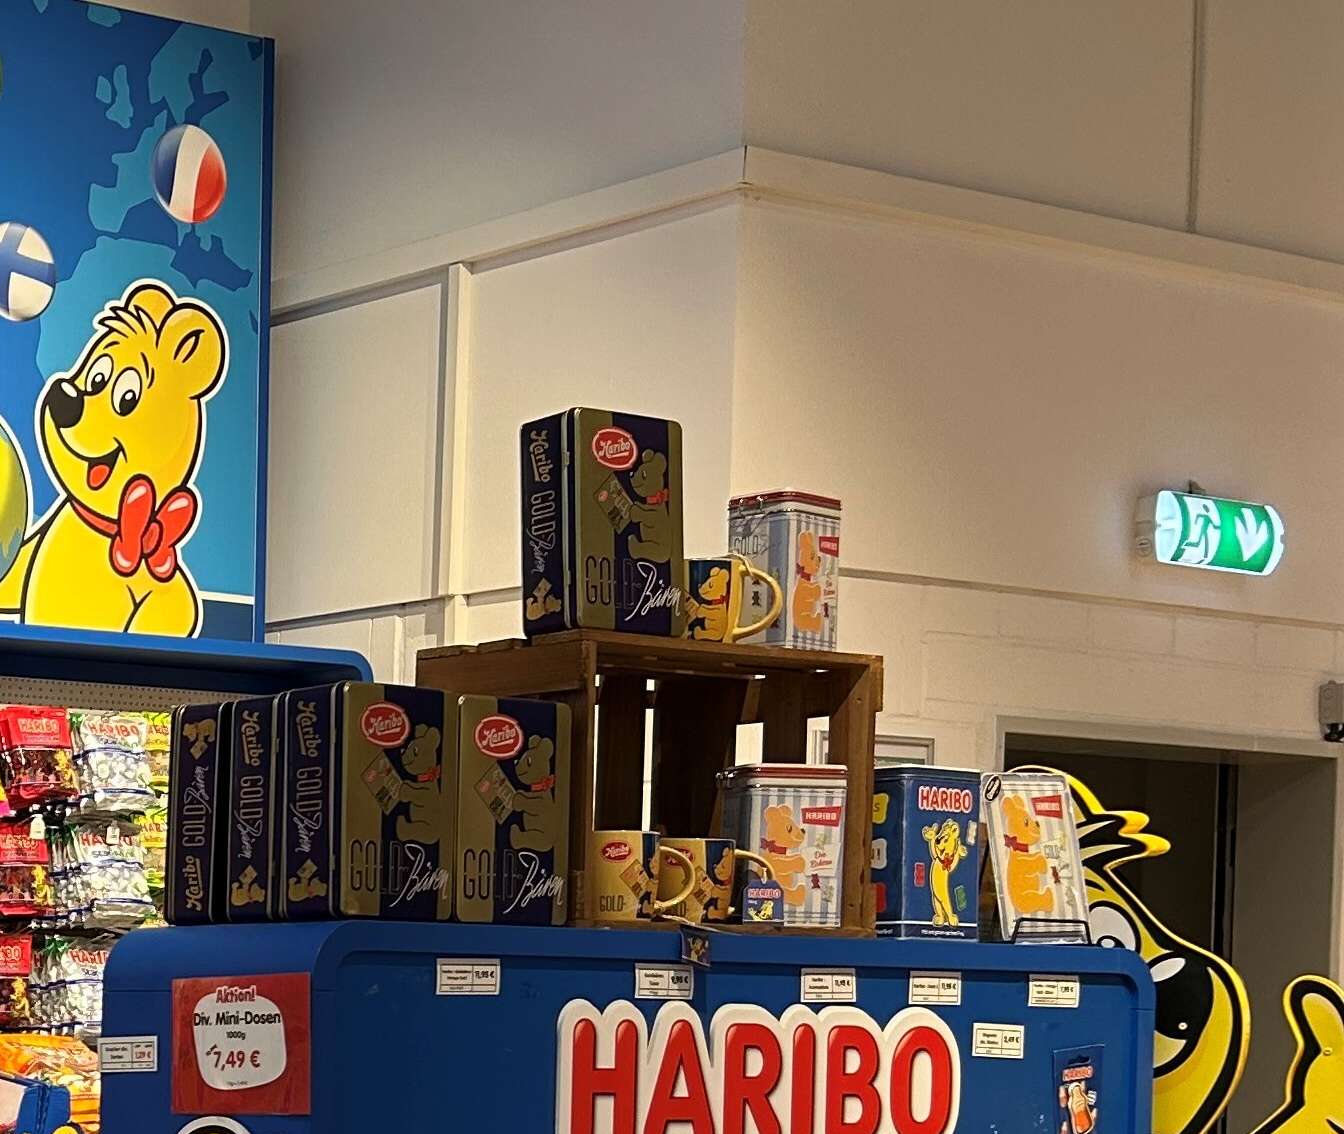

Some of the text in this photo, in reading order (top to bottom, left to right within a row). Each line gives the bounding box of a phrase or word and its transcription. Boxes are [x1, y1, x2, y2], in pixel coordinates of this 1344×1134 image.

[531, 430, 551, 482] Haribo
[598, 439, 631, 459] Haribo
[624, 562, 681, 620] Bären
[296, 700, 318, 756] Haribo
[369, 714, 402, 736] Haribo
[483, 724, 517, 749] Haribo
[243, 711, 261, 768] Haribo
[919, 786, 972, 814] HARIBO
[183, 856, 205, 911] Haribo
[390, 842, 449, 907] Bären
[503, 850, 564, 914] Bären
[215, 986, 255, 1004] Aktion!
[194, 1007, 281, 1026] Div. Mini-Dosen
[226, 1030, 246, 1042] 1000g
[214, 1049, 261, 1073] 7,49 €
